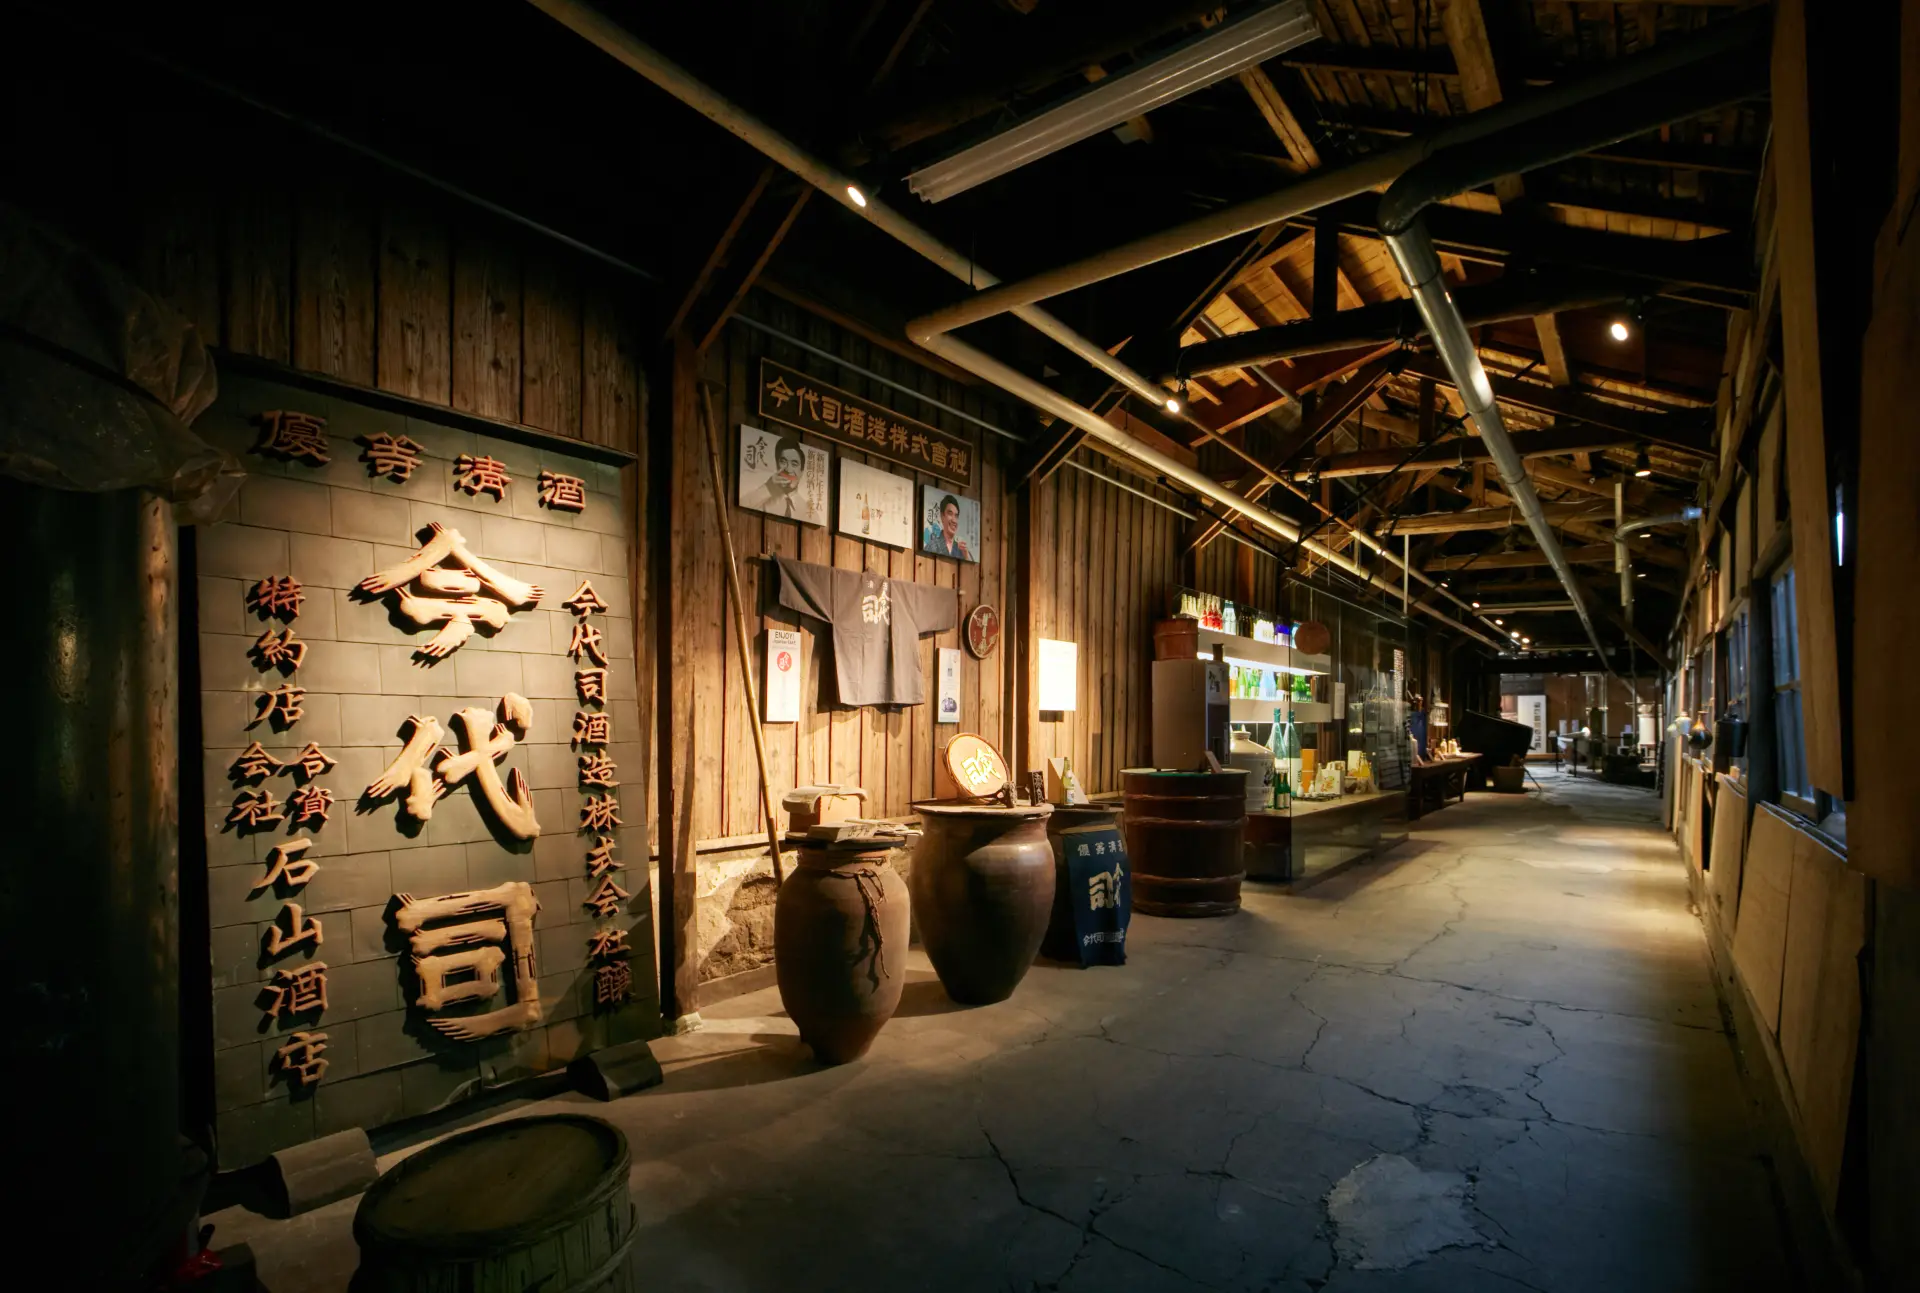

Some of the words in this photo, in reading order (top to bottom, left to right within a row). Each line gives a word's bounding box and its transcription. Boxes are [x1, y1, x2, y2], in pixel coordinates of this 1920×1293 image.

[258, 409, 587, 513] 優等清酒
[360, 521, 546, 1042] 今代司
